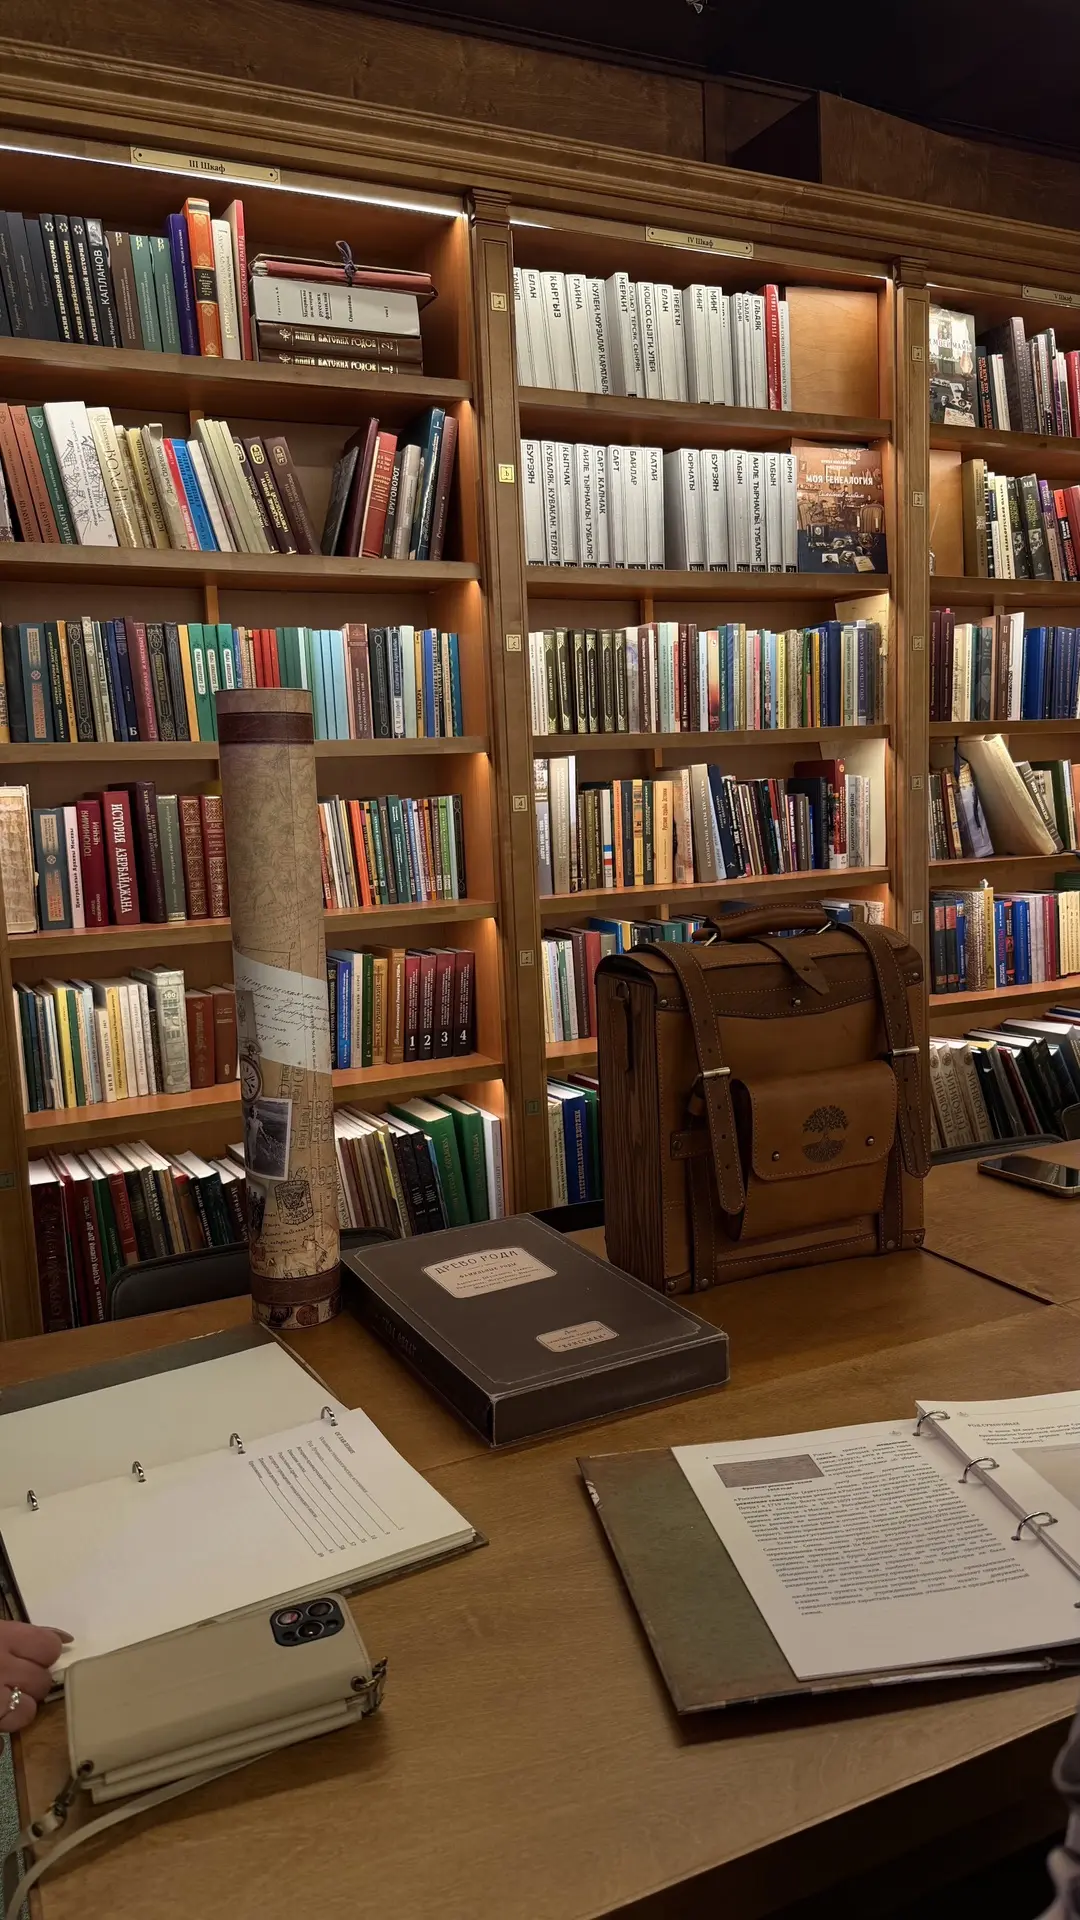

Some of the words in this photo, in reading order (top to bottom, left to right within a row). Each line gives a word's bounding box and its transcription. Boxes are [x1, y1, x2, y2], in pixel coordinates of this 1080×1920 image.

[200, 161, 226, 174] Шкаф
[47, 239, 59, 272] ИСТОРИИ
[63, 240, 74, 274] ИСТОРИИ
[237, 235, 246, 261] КРАЕВЕД
[695, 237, 714, 248] Шкаф
[77, 242, 88, 276] ИСТОРИИ
[90, 249, 113, 305] КАПЛАНОВ
[239, 263, 248, 306] МОСКОВСКИЙ
[528, 274, 537, 299] ЕЛАН
[53, 273, 67, 314] ЕВРЕЙСКОЙ
[69, 274, 81, 315] ЕВРЕЙСКОЙ
[82, 277, 95, 316] ЕВРЕЙСКОЙ
[550, 275, 561, 318] КЫРГЫЗ
[619, 277, 628, 313] МЕРКИТ
[661, 288, 669, 312] ЕЛАН
[710, 291, 718, 314] МИНГ
[61, 315, 71, 339] АРХИВ
[75, 315, 84, 340] АРХИВ
[90, 318, 99, 341] АРХИВ
[351, 337, 376, 348] РОДОВ
[351, 361, 376, 371] РОДОВ
[526, 444, 535, 484] БУРЗЯН
[562, 447, 571, 486] КЫПЧАК
[612, 449, 620, 471] САРТ
[629, 450, 637, 485] БАЙЛАР
[650, 451, 658, 481] КАТАЙ
[711, 454, 719, 492] БУРЗЯН
[388, 465, 400, 515] КРУГОВОРОТ
[598, 477, 606, 514] КАЛМАК
[806, 475, 823, 483] МОЯ
[826, 476, 873, 485] ГЕНЕАЛОГИЯ
[550, 530, 558, 556] ТЕЛЯУ
[585, 522, 593, 559] ТУБАЛЯС
[77, 809, 94, 857] ТОПОНИМИЯ
[90, 821, 102, 845] ЧЕЧНИ
[111, 803, 126, 844] ИСТОРИЯ
[115, 847, 133, 914] АЗЕРБАЙДЖАНА
[410, 1036, 415, 1046] 1
[424, 1035, 431, 1046] 2
[441, 1032, 448, 1043] 3
[460, 1030, 467, 1041] 4
[931, 1071, 954, 1134] ГЕРБОВНИК
[943, 1069, 966, 1130] ГЕРБОВНИК
[965, 1069, 988, 1129] ГЕРБОВНИК
[145, 1169, 157, 1191] ШУША
[149, 1192, 163, 1221] СТАРАЯ
[435, 1258, 477, 1275] ДРЕВО
[481, 1250, 519, 1262] РОДА
